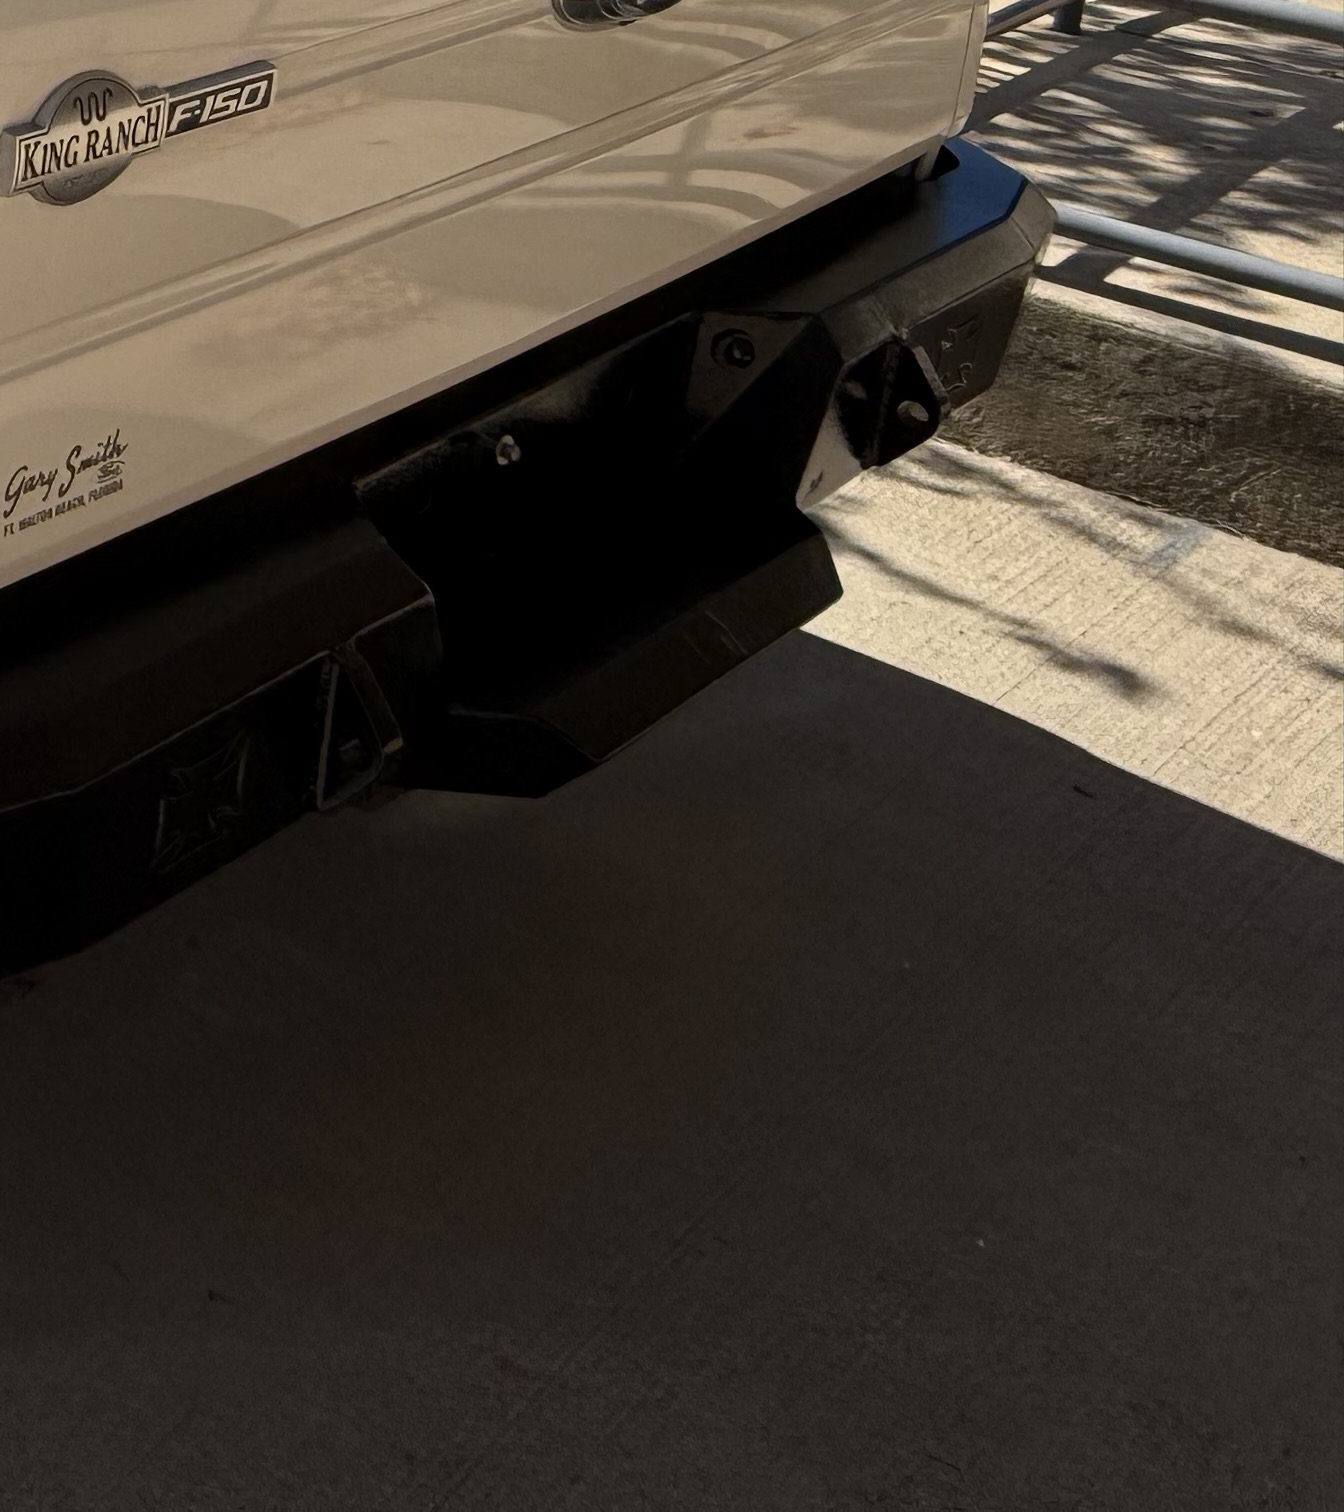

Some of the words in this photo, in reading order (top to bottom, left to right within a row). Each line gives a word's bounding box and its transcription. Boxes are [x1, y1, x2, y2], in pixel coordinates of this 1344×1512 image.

[20, 133, 79, 183] KING
[83, 105, 162, 163] RANCH
[3, 464, 59, 519] Gary
[58, 428, 129, 499] Smith
